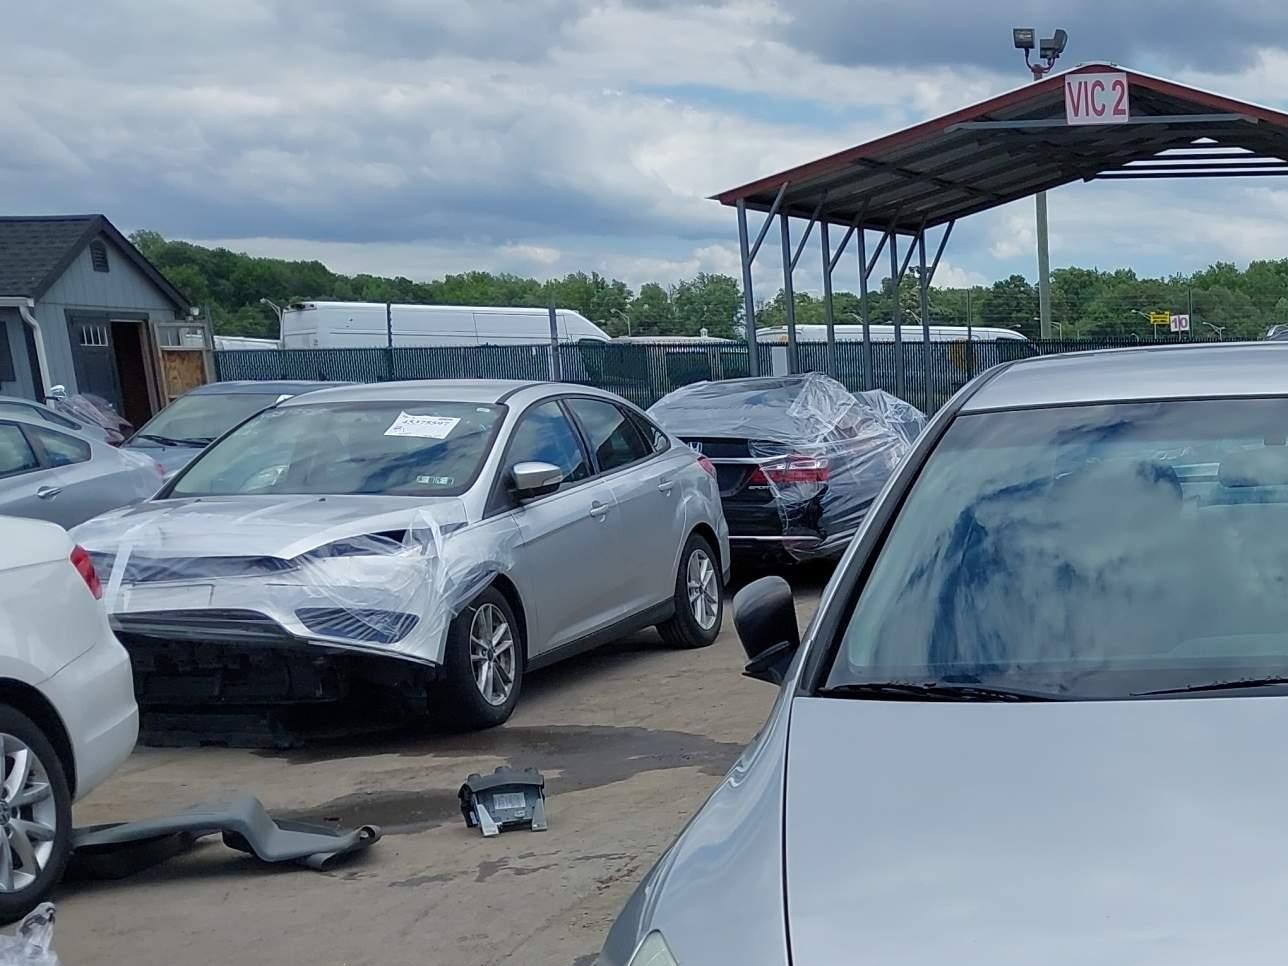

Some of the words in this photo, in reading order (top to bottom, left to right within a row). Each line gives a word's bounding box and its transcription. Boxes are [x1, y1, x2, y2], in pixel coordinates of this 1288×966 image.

[1067, 80, 1106, 117] VIC
[1112, 80, 1126, 115] 2
[1172, 316, 1188, 329] 10
